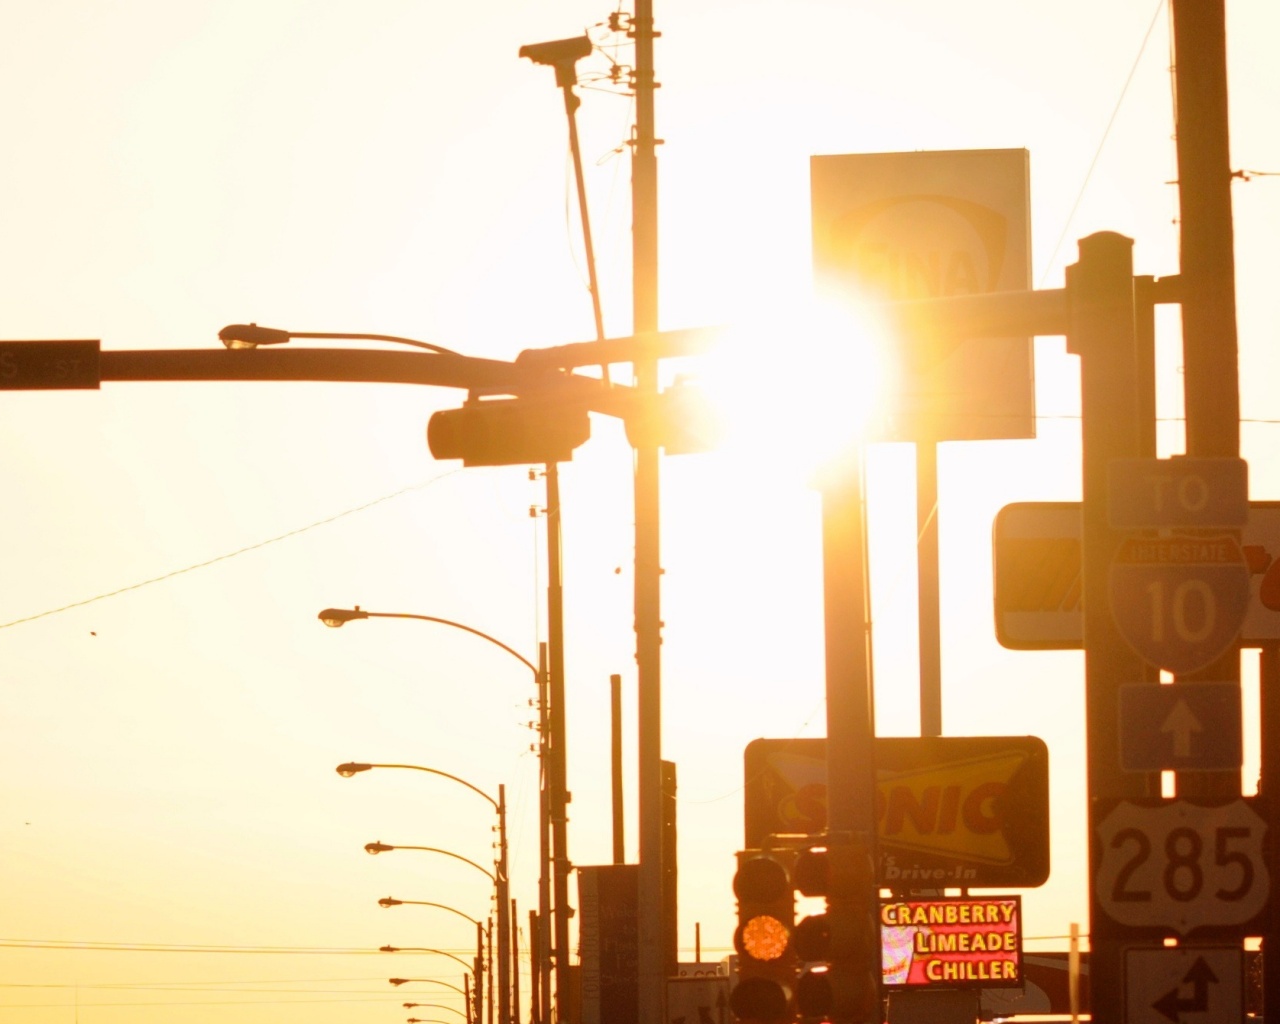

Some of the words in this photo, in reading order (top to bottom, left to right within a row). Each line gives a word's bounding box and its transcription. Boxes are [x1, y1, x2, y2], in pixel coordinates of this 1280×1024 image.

[1144, 474, 1210, 513] TO
[1128, 544, 1227, 562] INTERSTATE
[1147, 578, 1217, 643] 10
[784, 782, 1008, 835] SNIC
[1110, 826, 1256, 903] 285
[882, 904, 1015, 925] CRANBERRY
[915, 932, 1016, 953] LIMEADE
[925, 960, 1017, 981] CHILLER
